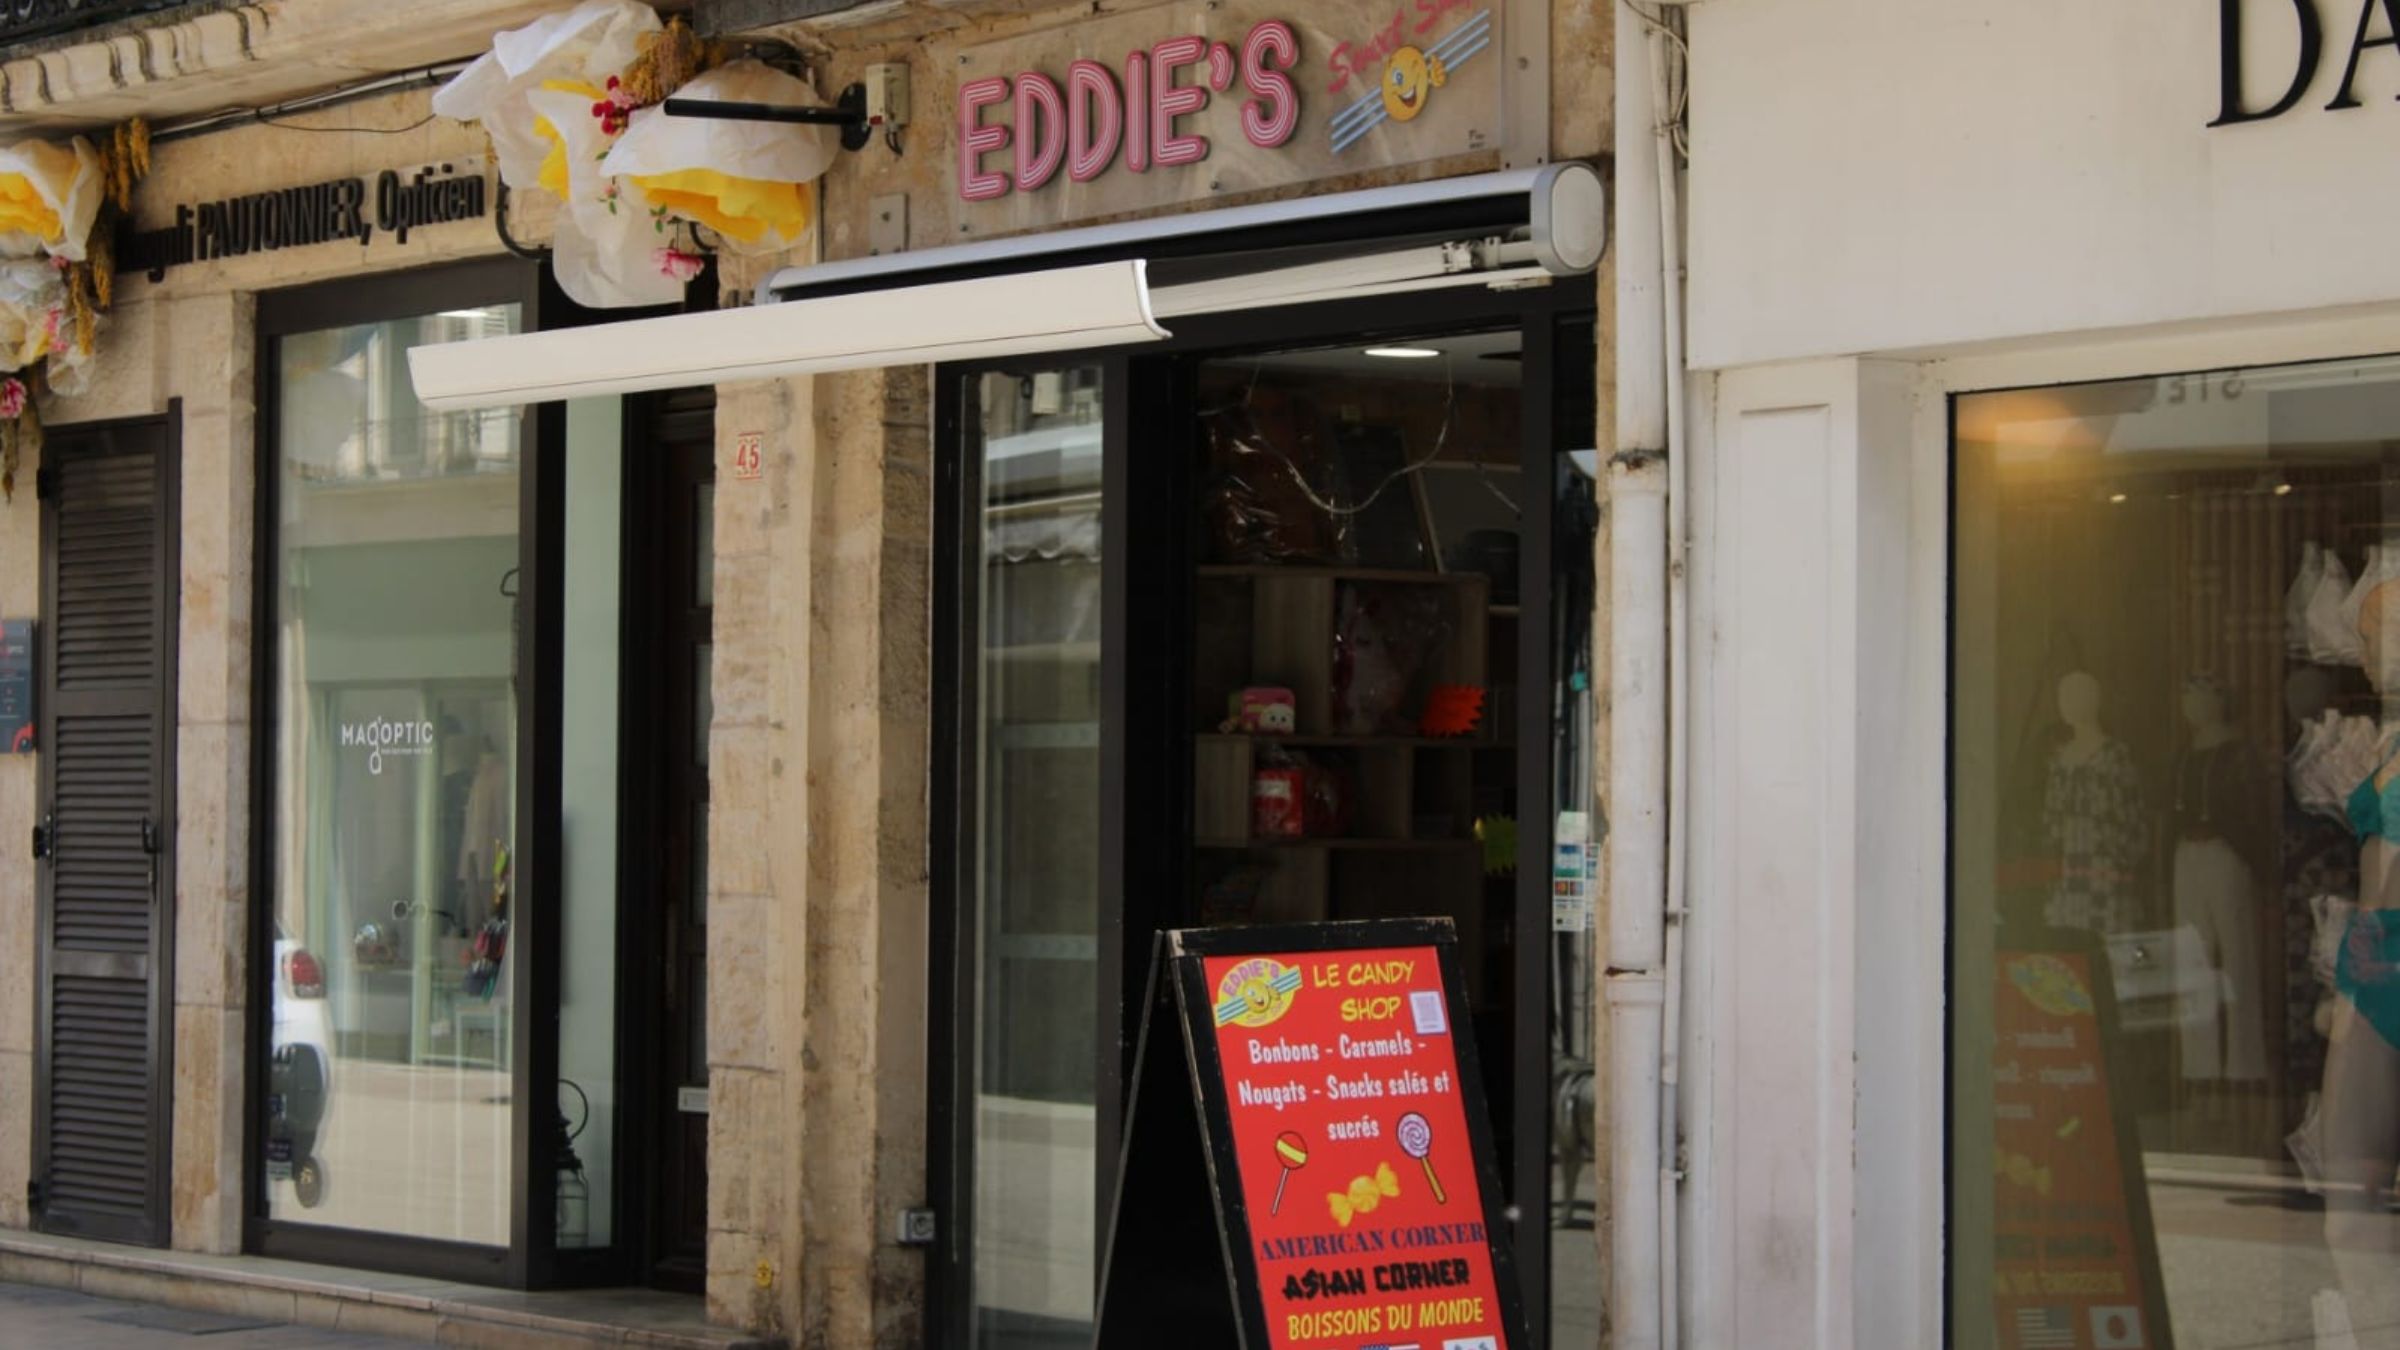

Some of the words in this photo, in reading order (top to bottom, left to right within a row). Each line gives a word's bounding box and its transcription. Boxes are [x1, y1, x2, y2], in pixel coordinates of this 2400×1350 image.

[959, 19, 1299, 201] EDDIE'S
[197, 177, 371, 261] PAUTONNIER,
[377, 163, 485, 244] Opticien
[736, 443, 760, 470] 45
[1313, 964, 1341, 988] LE
[1347, 960, 1415, 986] CANDY
[1341, 996, 1401, 1022] SHOP
[1248, 1036, 1320, 1064] Bonbons
[1339, 1030, 1413, 1059] Caramels
[1238, 1079, 1307, 1112] Nougats
[1326, 1072, 1384, 1100] Snacks
[1388, 1069, 1429, 1096] salés
[1433, 1070, 1450, 1093] et
[1327, 1115, 1380, 1141] sucrés
[1260, 1230, 1384, 1261] AMERICAN
[1391, 1222, 1487, 1249] CORNER
[1282, 1268, 1366, 1301] ASIAN
[1374, 1258, 1470, 1292] CORNER
[1287, 1306, 1382, 1341] BOISSONS
[1387, 1303, 1413, 1331] DU
[1419, 1297, 1485, 1329] MONDE
